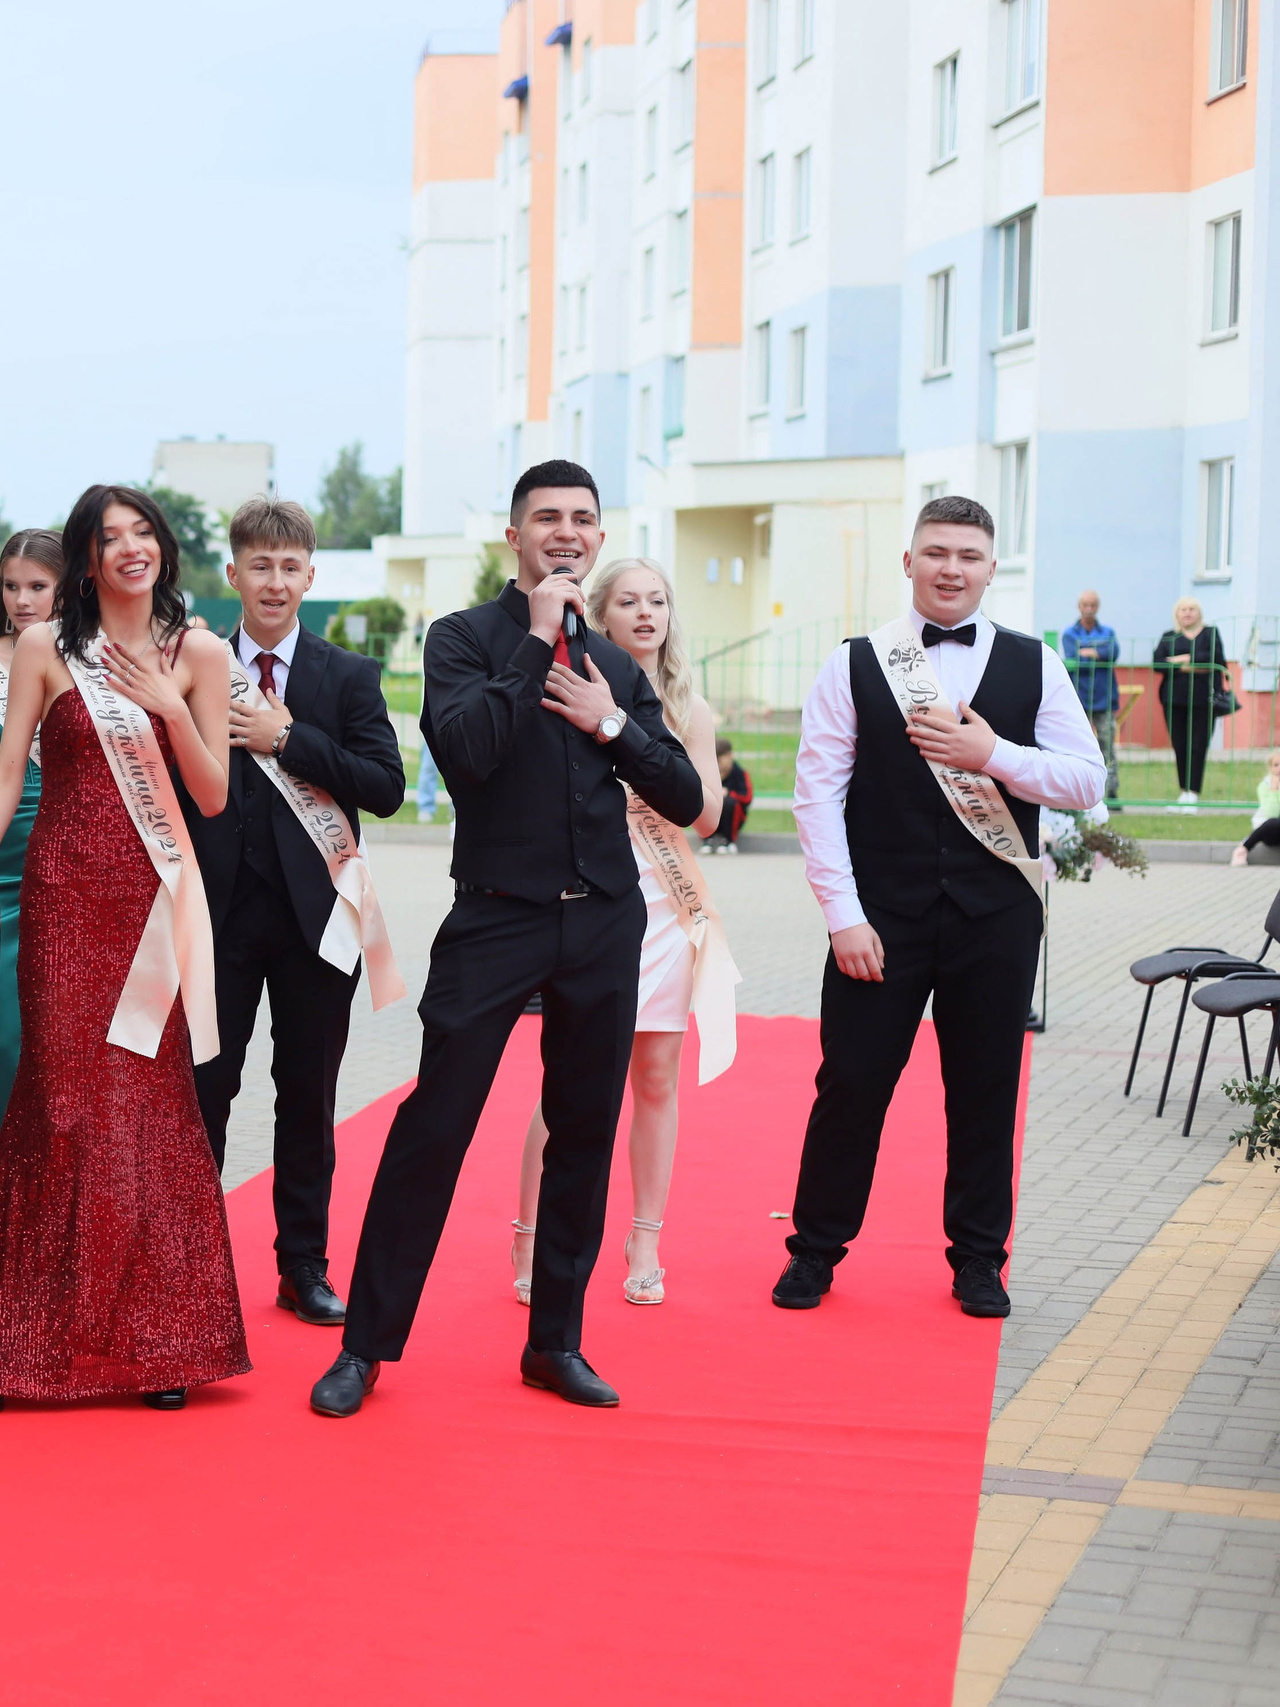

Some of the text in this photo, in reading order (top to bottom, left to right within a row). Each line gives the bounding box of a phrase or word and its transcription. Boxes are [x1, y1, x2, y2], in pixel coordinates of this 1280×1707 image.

[81, 655, 182, 864] Выпускница 2024
[105, 728, 118, 756] Средняя
[116, 757, 126, 778] школа
[280, 779, 295, 797] школа
[312, 810, 350, 865] 2024
[679, 879, 709, 925] 2024
